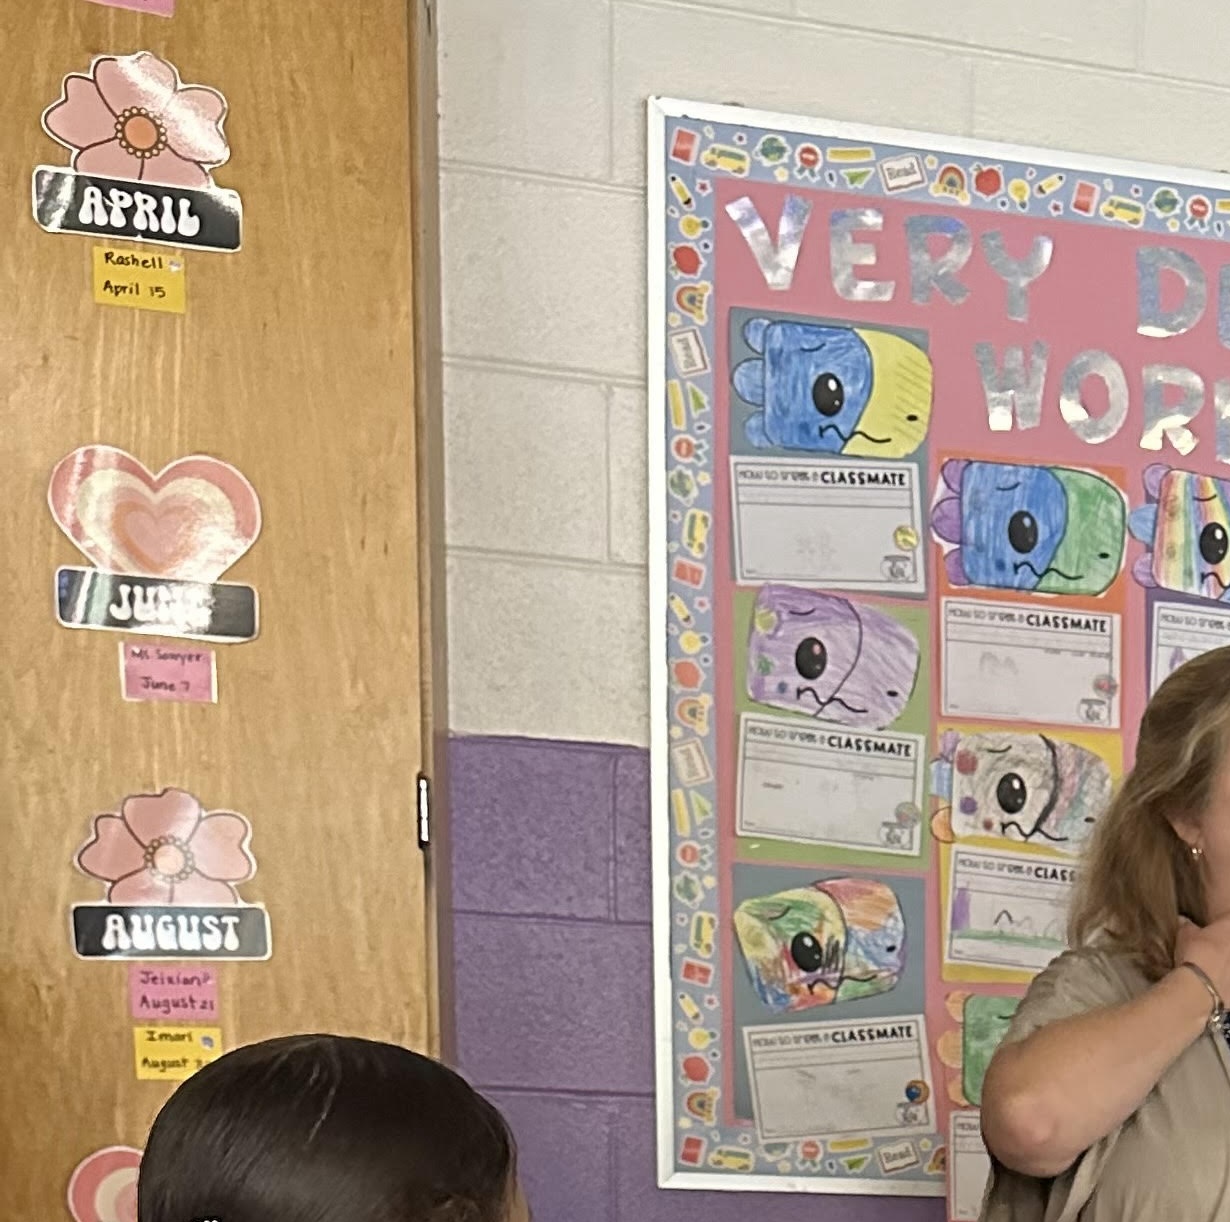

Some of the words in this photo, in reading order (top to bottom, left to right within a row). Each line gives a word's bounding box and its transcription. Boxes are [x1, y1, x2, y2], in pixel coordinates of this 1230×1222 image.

[78, 186, 200, 237] APRIL
[725, 194, 1053, 322] VERY
[103, 280, 139, 297] April
[149, 286, 166, 298] 15
[821, 471, 905, 486] CLASSMATE
[1026, 614, 1106, 633] CLASSMATE
[827, 735, 912, 757] CLASSMATE
[101, 913, 241, 951] AUGUST
[140, 995, 196, 1014] August
[831, 1025, 912, 1044] CLASSMATE
